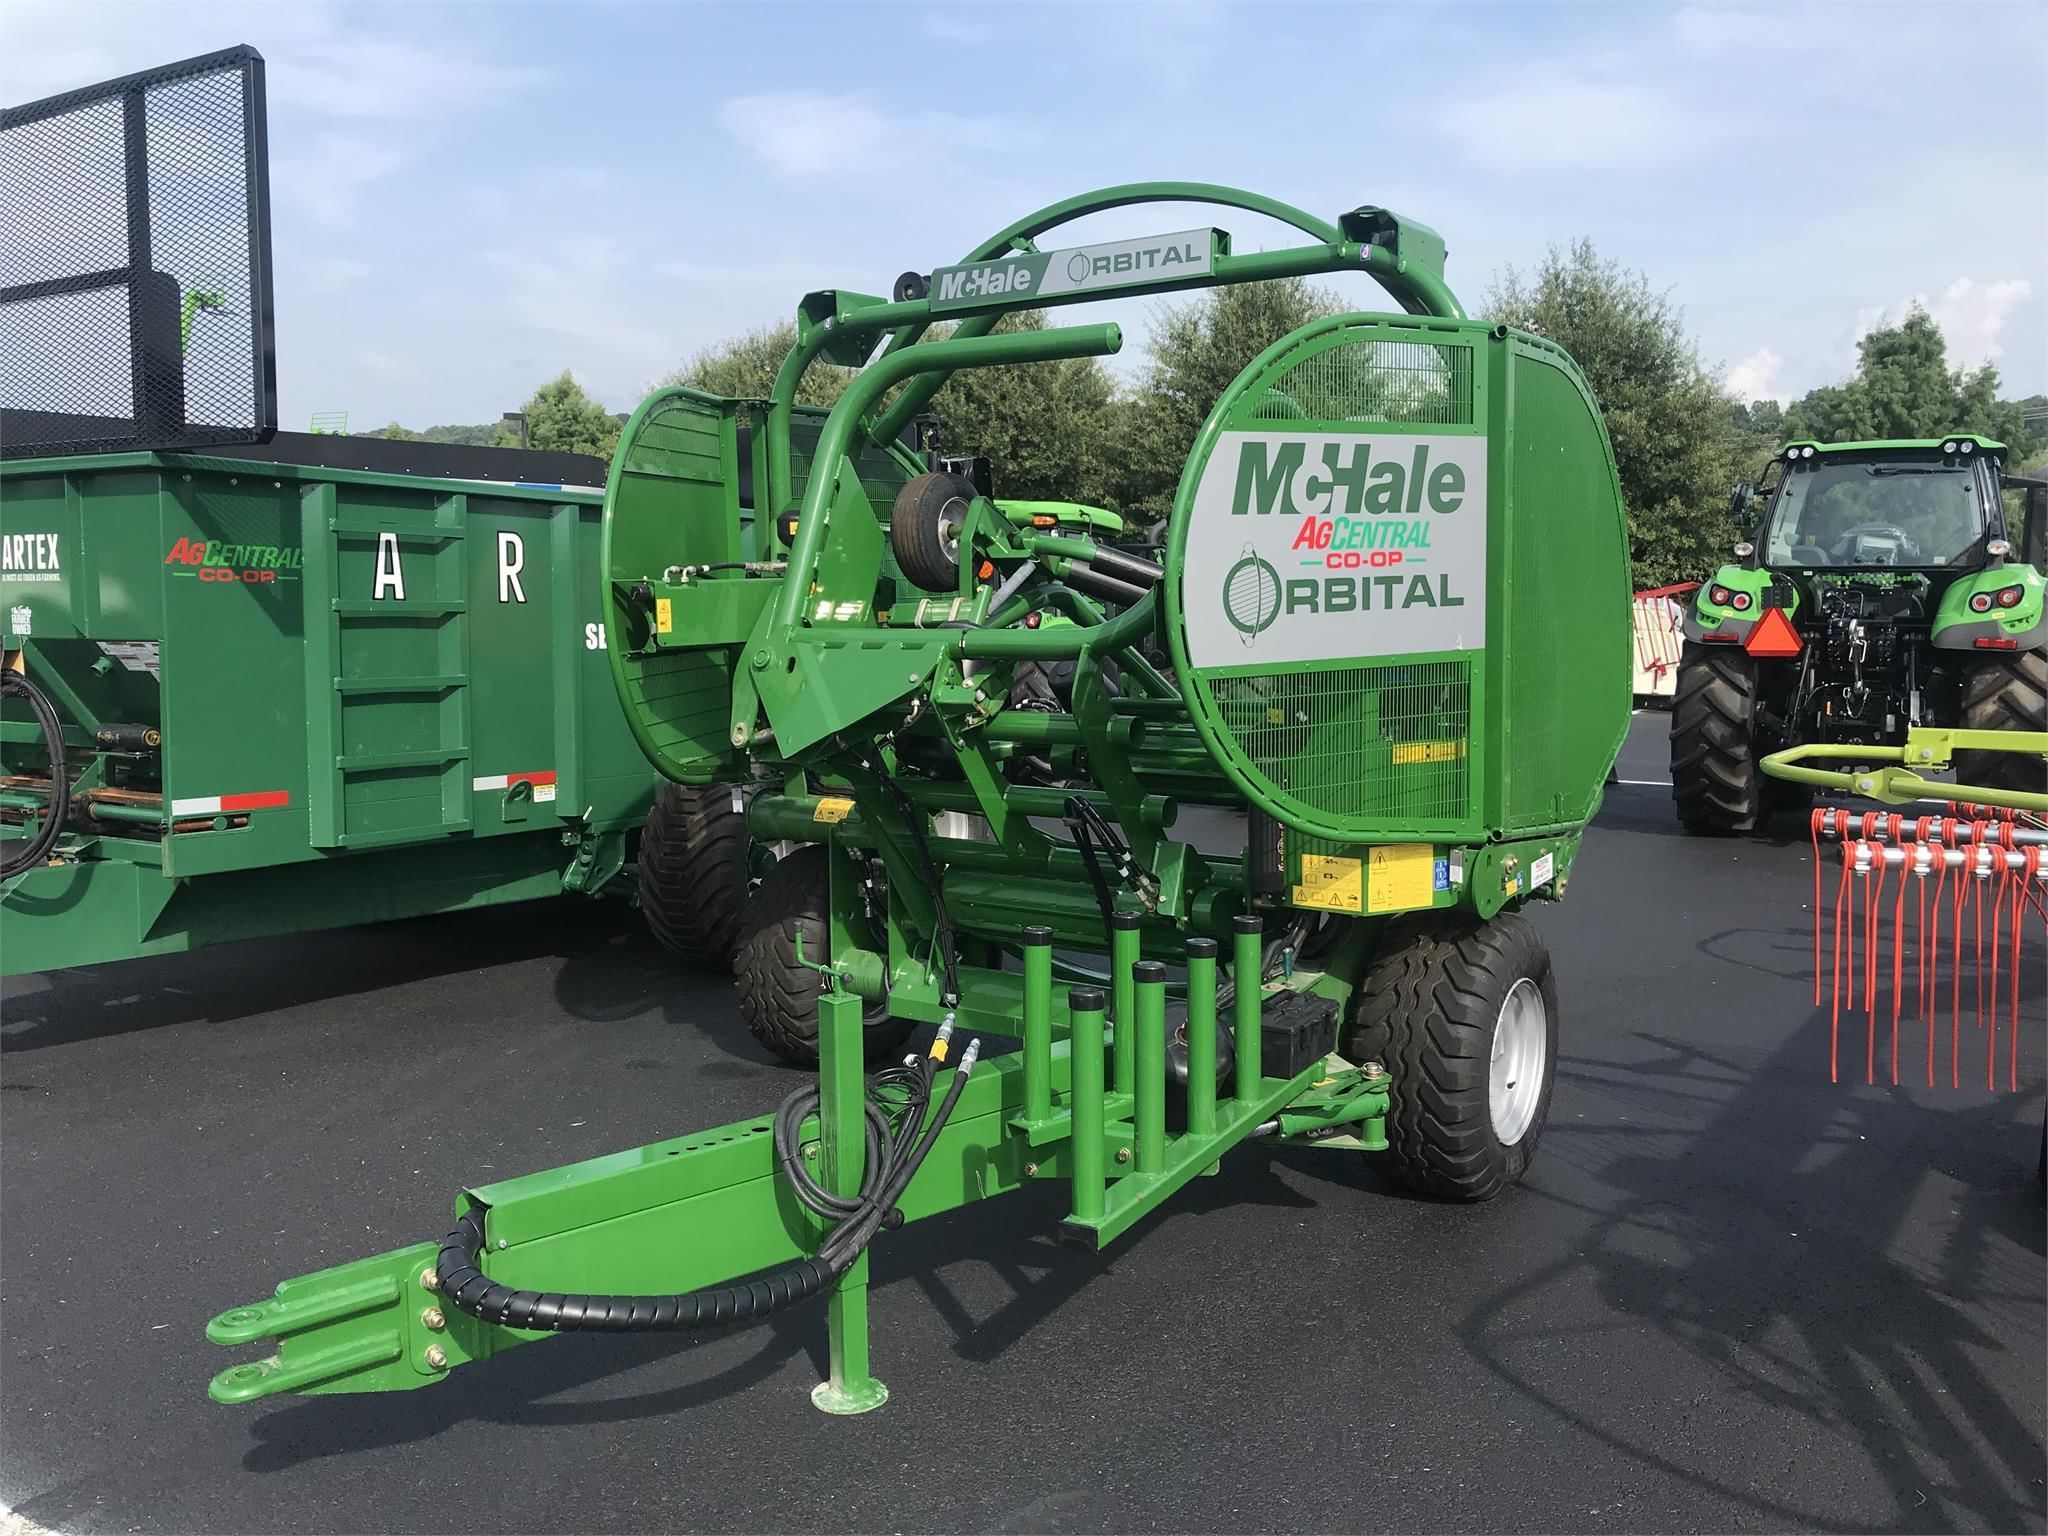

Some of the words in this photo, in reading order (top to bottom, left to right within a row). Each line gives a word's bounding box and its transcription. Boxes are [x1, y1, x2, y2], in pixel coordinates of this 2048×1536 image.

[939, 264, 1031, 300] McHale
[1067, 244, 1202, 284] ORBITAL
[1231, 442, 1466, 515] McHale
[2, 533, 60, 570] ARTEX
[198, 567, 275, 582] CO-OP
[373, 531, 407, 600] A
[497, 531, 527, 603] R
[1326, 551, 1403, 569] CO-OP
[1223, 557, 1465, 633] ORBITAL
